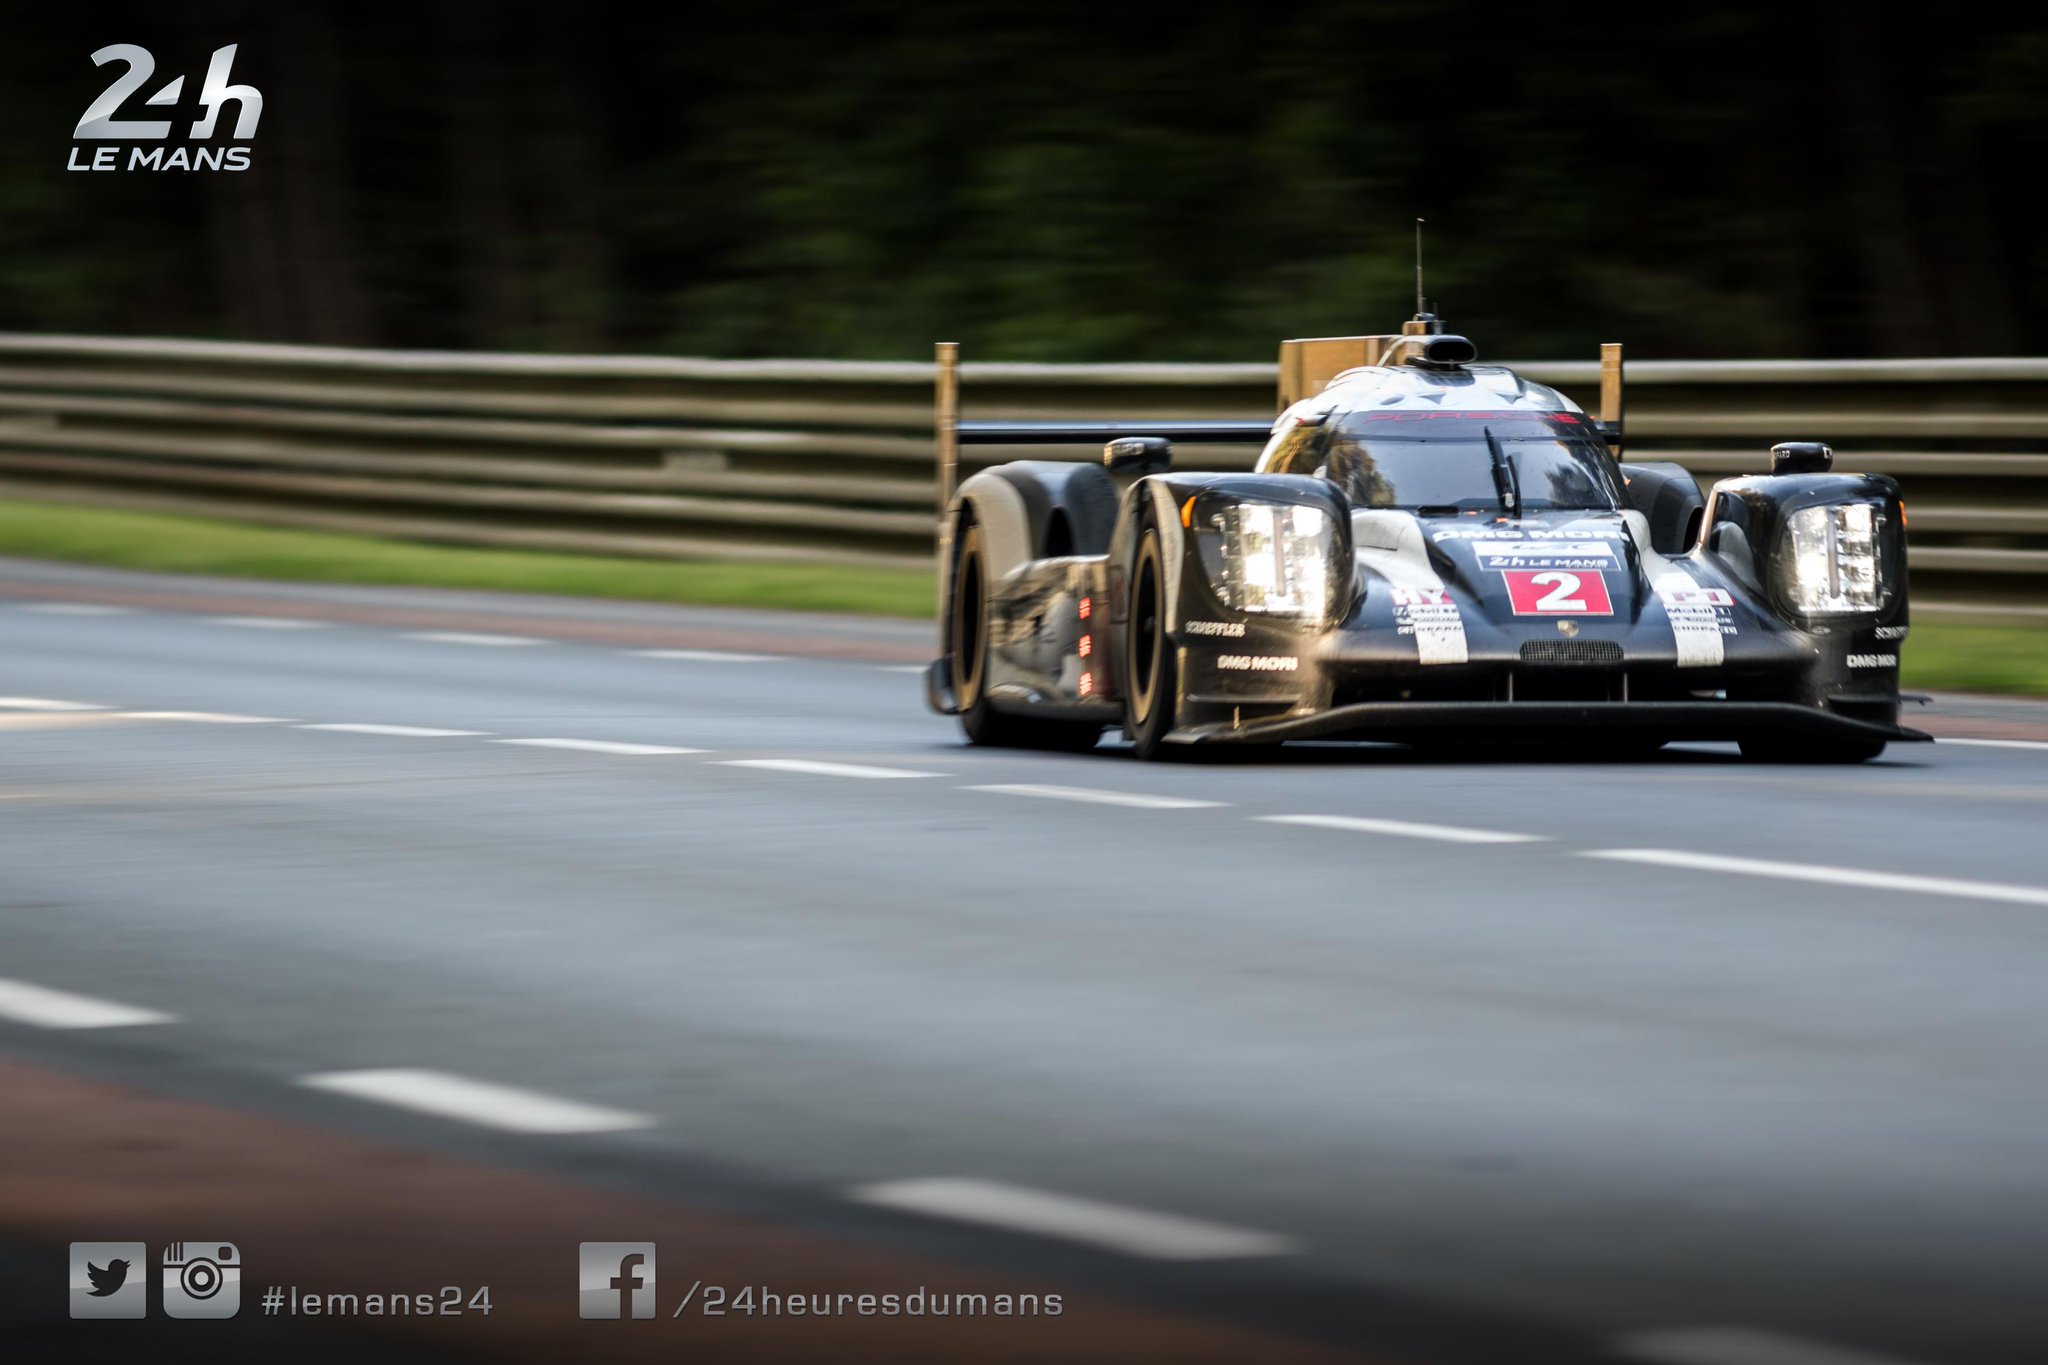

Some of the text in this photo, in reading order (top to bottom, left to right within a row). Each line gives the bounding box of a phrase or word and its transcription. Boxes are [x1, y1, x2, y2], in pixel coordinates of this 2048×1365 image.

[1529, 559, 1551, 567] LE
[1555, 559, 1608, 568] MANS
[1531, 571, 1588, 611] 2
